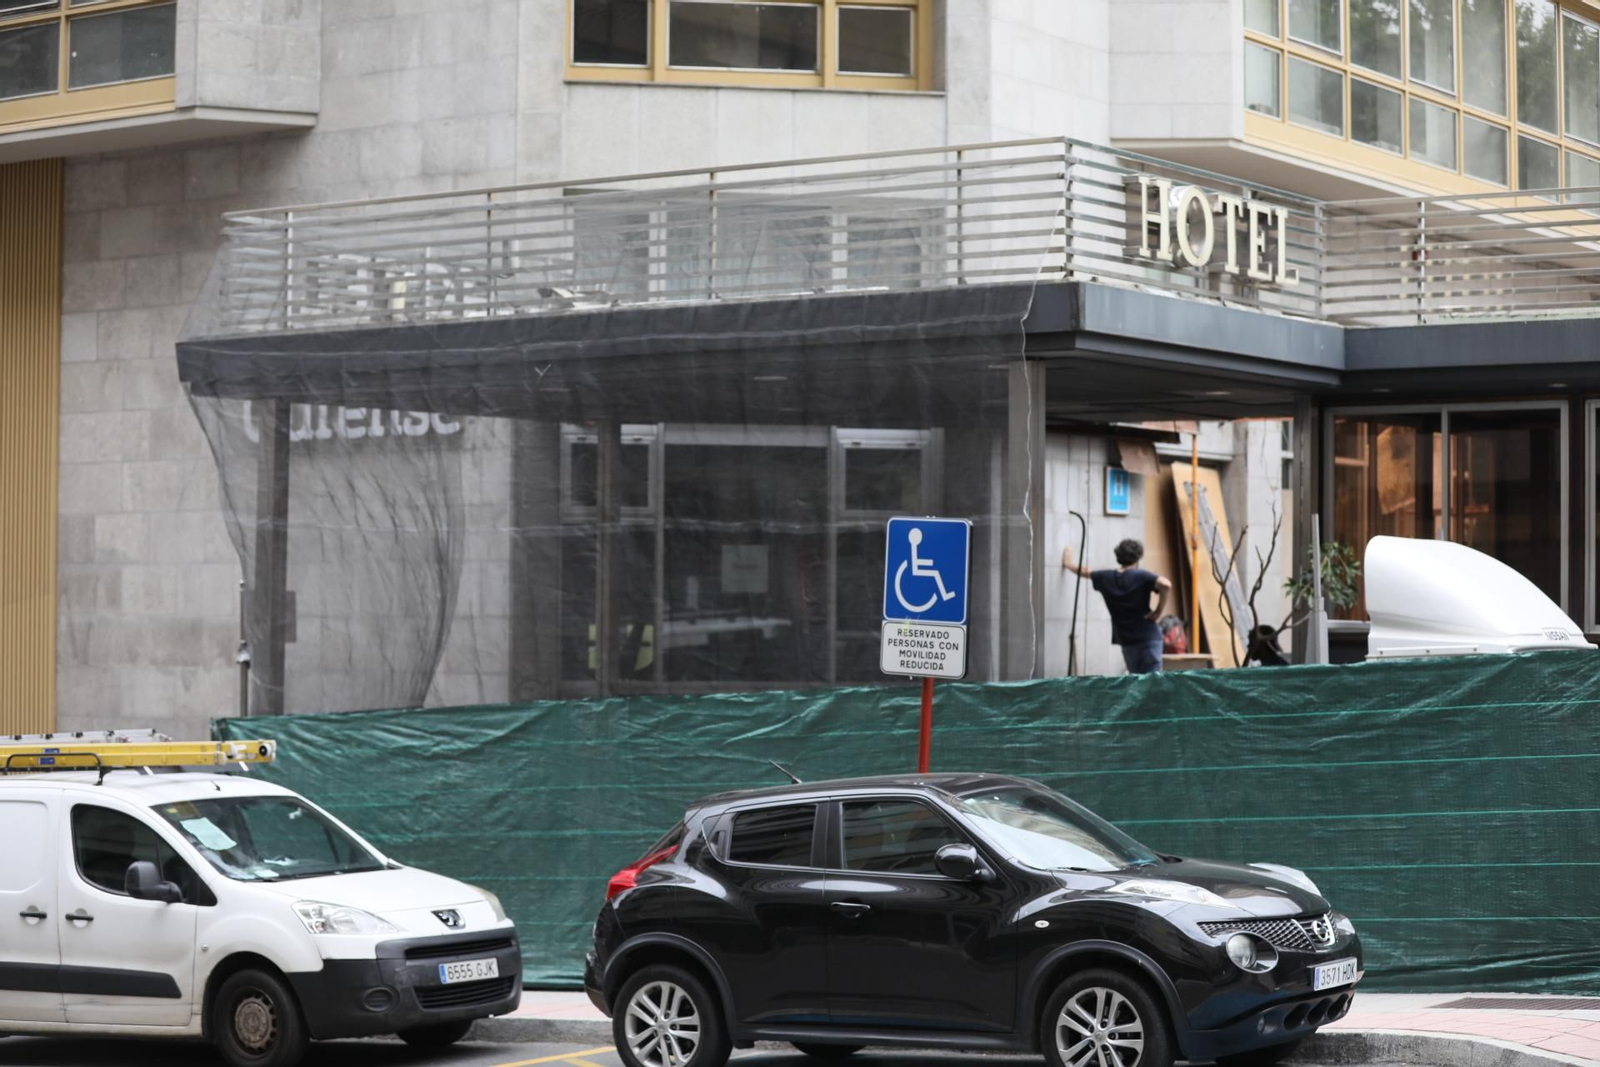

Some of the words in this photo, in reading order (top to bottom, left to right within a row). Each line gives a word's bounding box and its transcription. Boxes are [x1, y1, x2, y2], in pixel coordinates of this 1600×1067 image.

[1137, 175, 1299, 285] HOTEL
[897, 628, 950, 640] RESERVADO
[887, 638, 935, 650] PERSONAS
[938, 641, 959, 651] CON
[899, 649, 946, 661] MOVILIDAD
[900, 660, 944, 671] REDUCIDA
[446, 963, 474, 980] 6555
[476, 960, 495, 977] GJK
[1320, 967, 1341, 986] 3571
